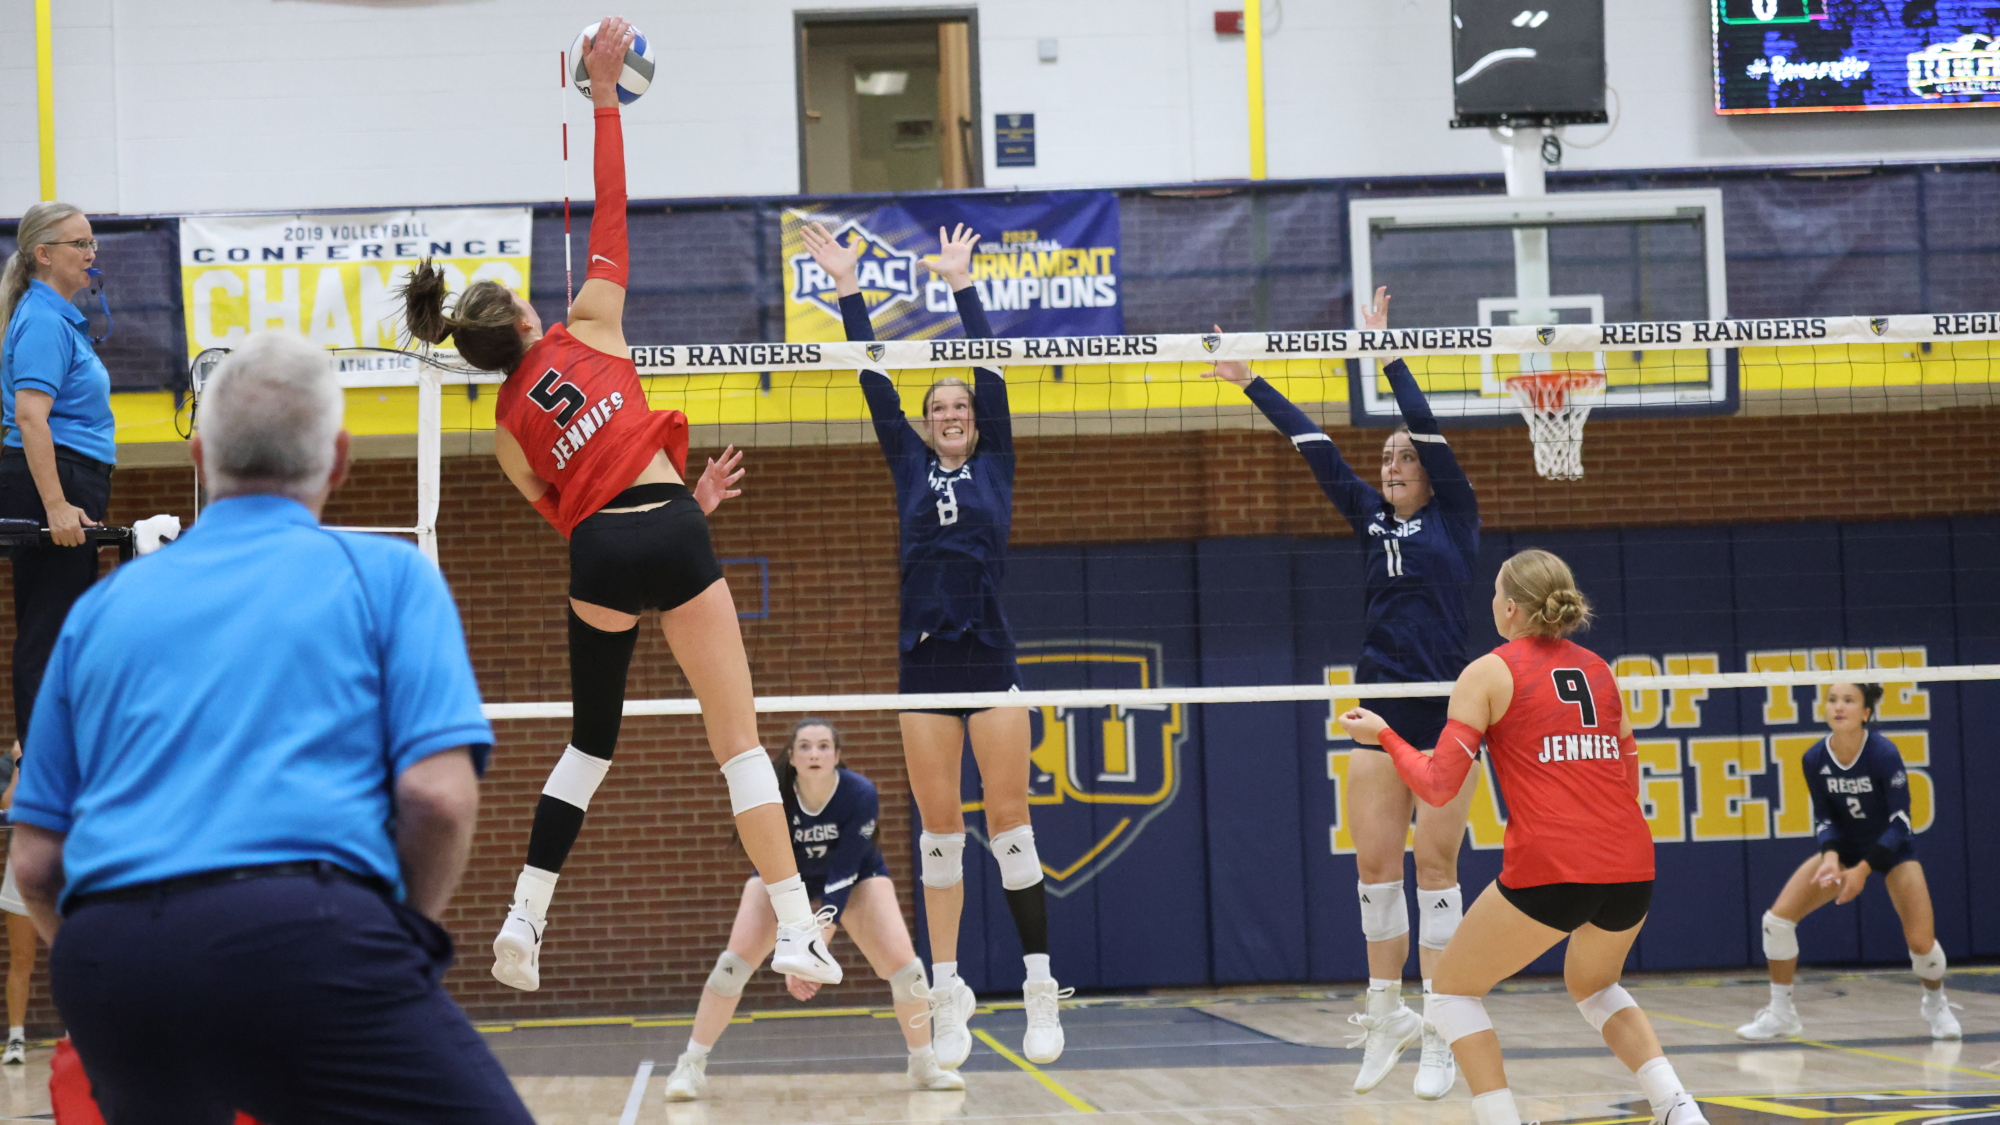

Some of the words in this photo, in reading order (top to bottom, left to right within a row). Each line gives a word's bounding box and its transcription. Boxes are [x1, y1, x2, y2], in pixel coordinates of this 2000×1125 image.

[284, 226, 323, 242] 2019
[330, 222, 429, 240] VOLLEYBALL
[193, 239, 521, 263] CONFERENCE
[924, 246, 1116, 282] TURNAMENT
[801, 260, 909, 294] RAC
[1600, 322, 1682, 345] REGIS
[1692, 318, 1827, 343] RANGERS
[1933, 313, 2000, 335] REGI
[929, 339, 1012, 361] REGIS
[1023, 335, 1158, 358] RANGERS
[1265, 331, 1347, 353] REGIS
[1358, 328, 1493, 350] RANGERS
[339, 356, 412, 373] ATHLETIC
[631, 346, 675, 367] GIS
[686, 343, 821, 366] RANGERS
[526, 367, 587, 430] 5
[551, 391, 624, 470] JENNIES
[936, 490, 958, 526] 8
[1383, 539, 1404, 577] 11
[1551, 667, 1598, 728] 9
[1611, 653, 1719, 730] OF
[1538, 734, 1620, 763] JENNIES
[1826, 776, 1873, 795] REGIS
[1846, 797, 1867, 819] 2
[794, 823, 839, 843] REGIS
[805, 845, 828, 858] 17
